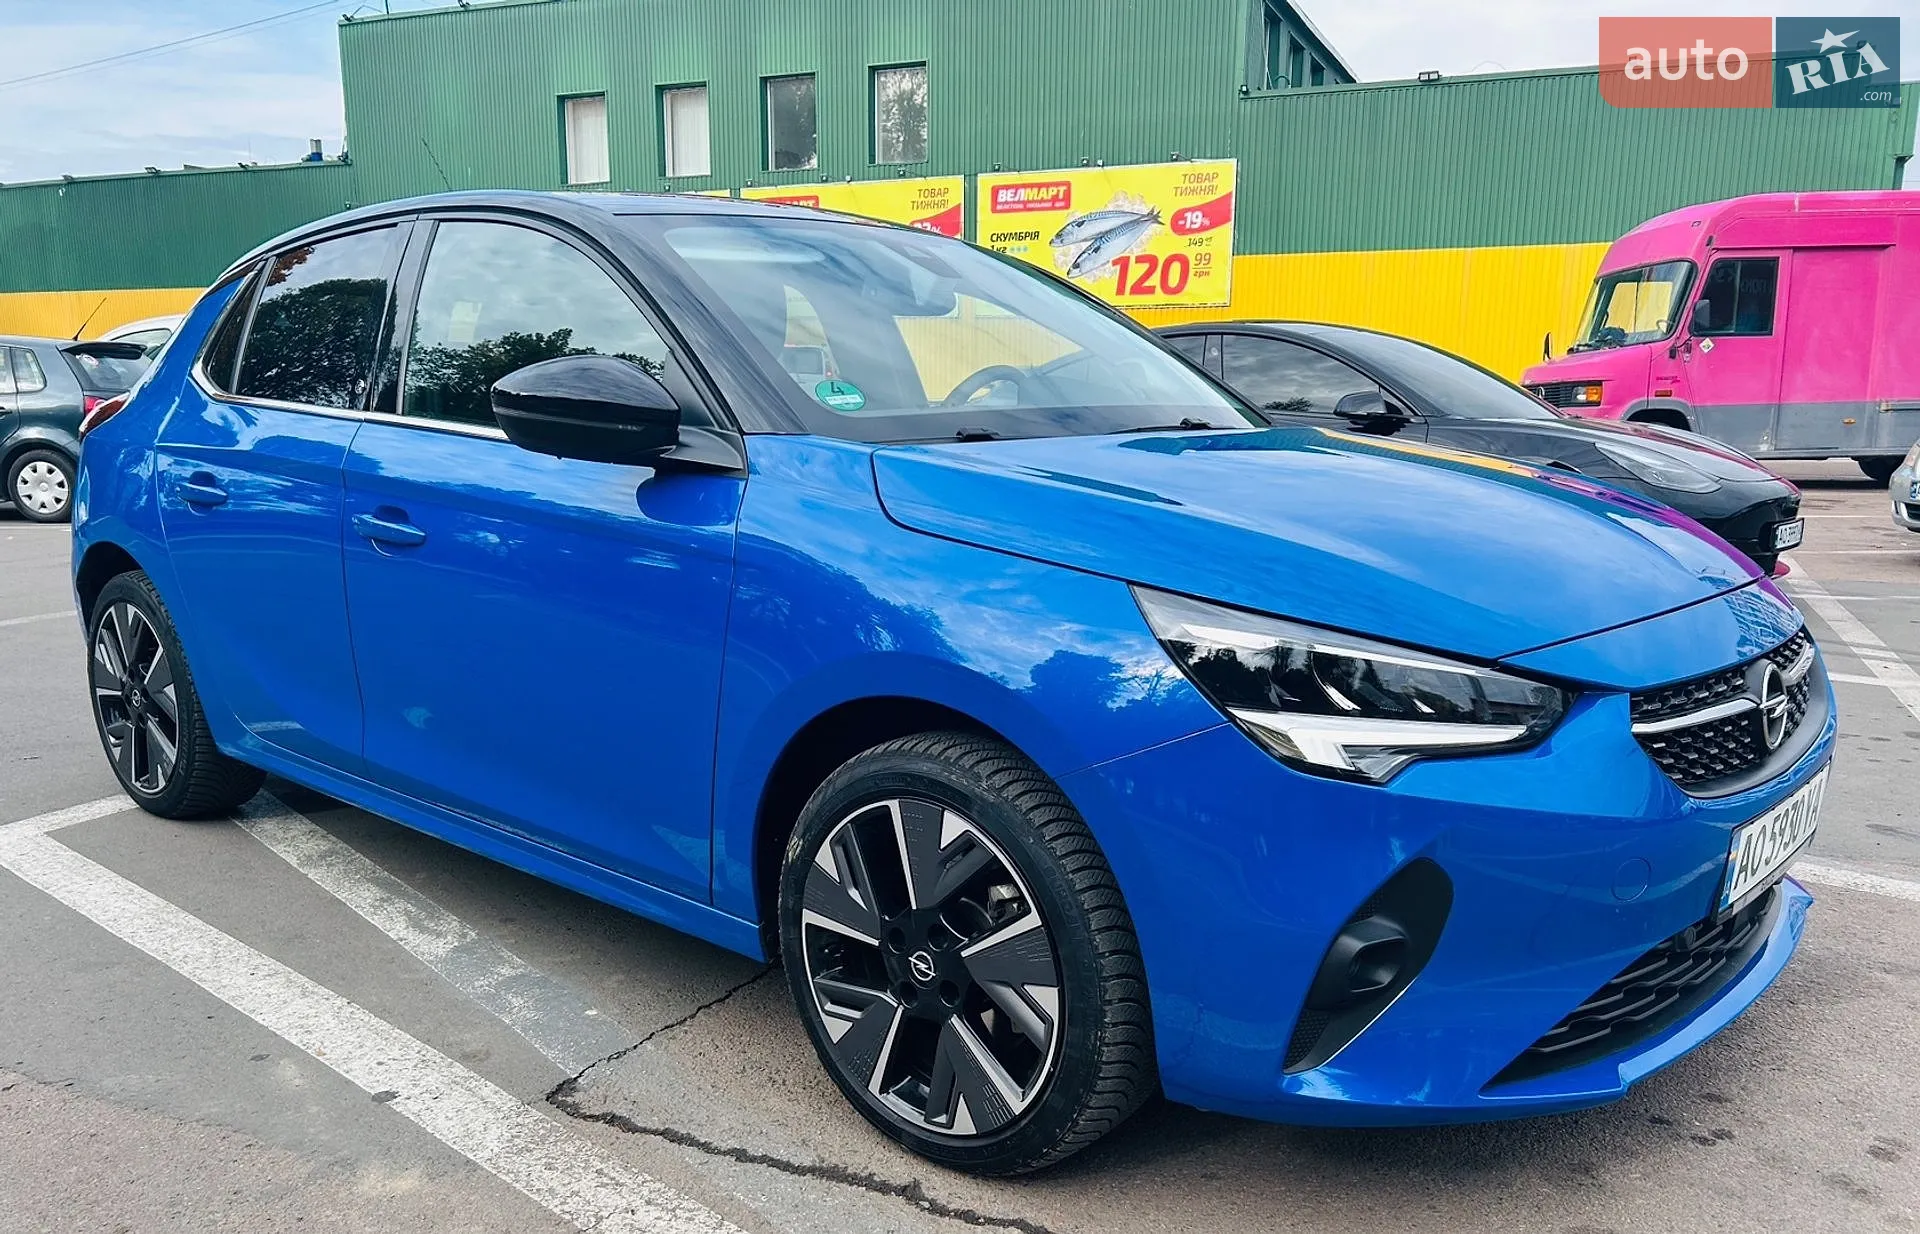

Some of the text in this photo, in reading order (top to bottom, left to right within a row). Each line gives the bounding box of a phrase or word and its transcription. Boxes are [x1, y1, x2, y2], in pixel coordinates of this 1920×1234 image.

[1182, 172, 1219, 184] ТОВАР
[917, 187, 949, 199] ТОВАР
[997, 186, 1067, 201] ВЕЛМАРТ
[1174, 184, 1218, 197] ТИЖНЯ!
[910, 199, 949, 210] ТИЖНЯ!
[1178, 211, 1211, 229] -19%
[990, 231, 1040, 243] СКУМБРІЯ
[1111, 252, 1212, 297] 120 99
[1193, 270, 1210, 279] грн
